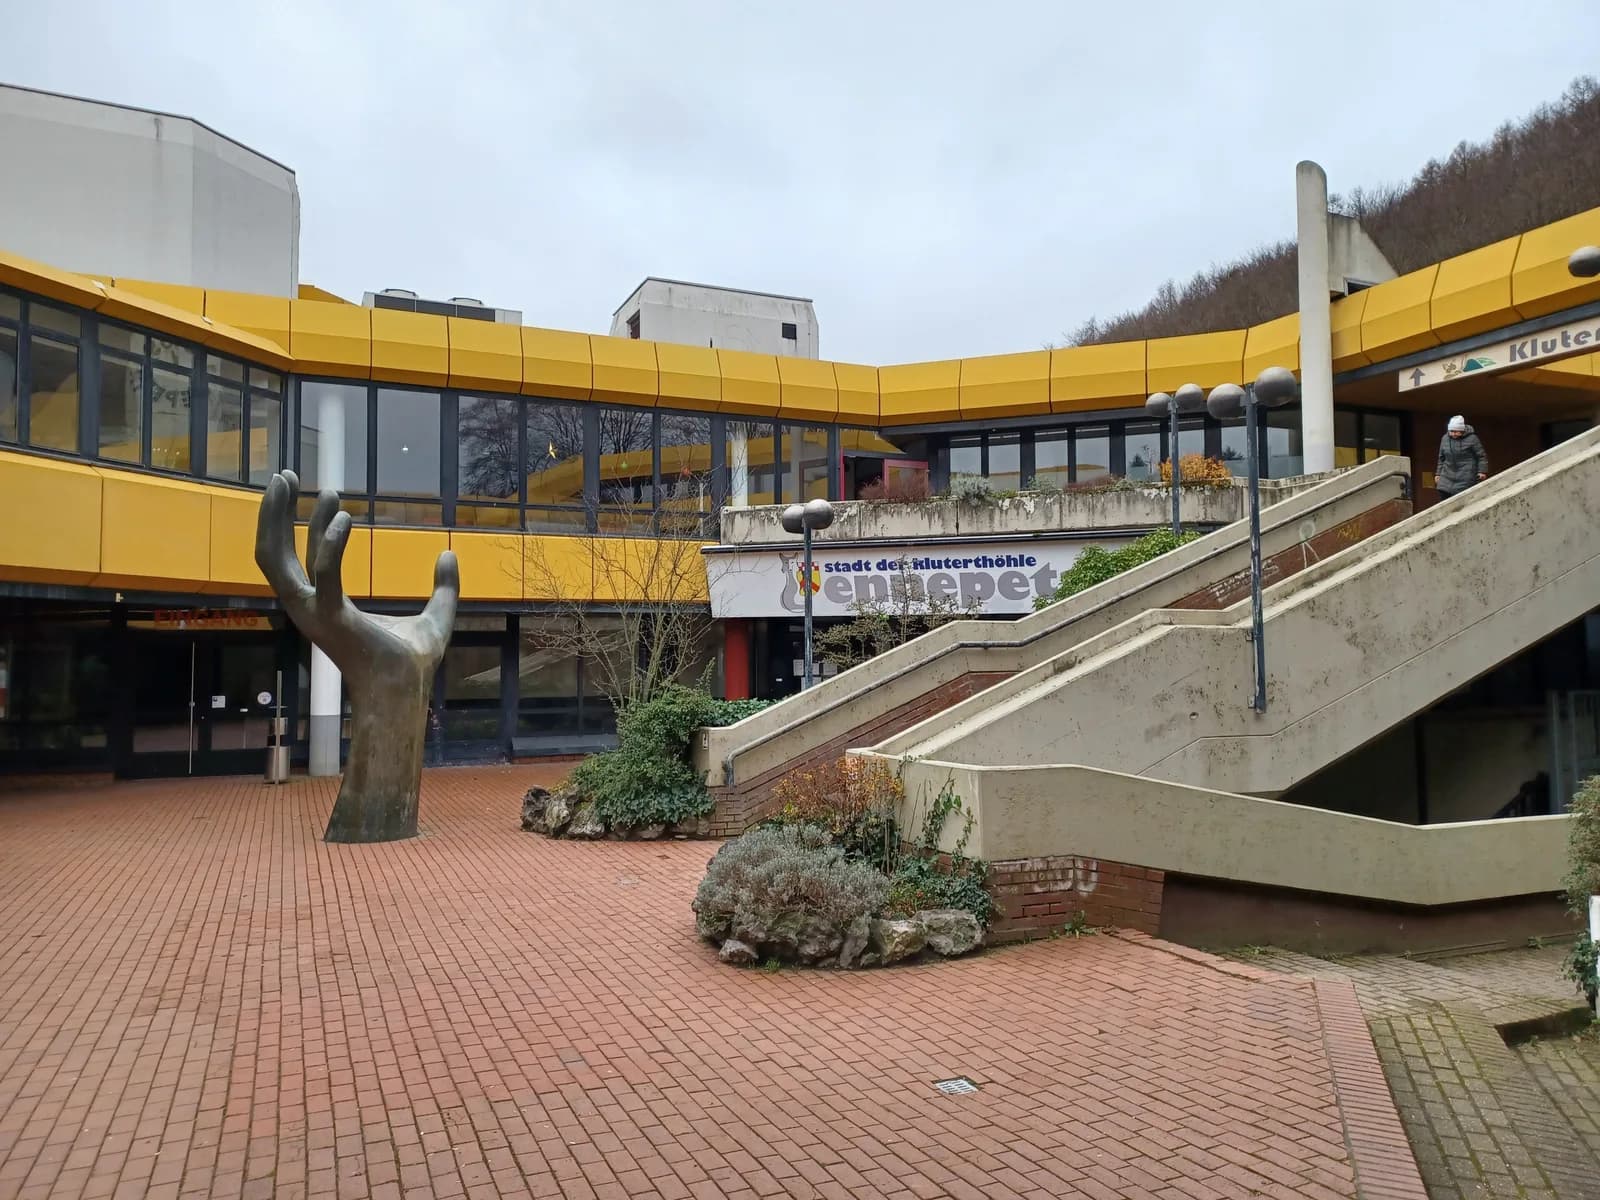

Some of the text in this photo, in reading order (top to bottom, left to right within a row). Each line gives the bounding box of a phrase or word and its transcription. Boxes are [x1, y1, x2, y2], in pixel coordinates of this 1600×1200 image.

[824, 554, 1037, 572] stadt der kluterthöhle
[823, 562, 1072, 609] ennepet
[153, 608, 259, 626] EINGANG
